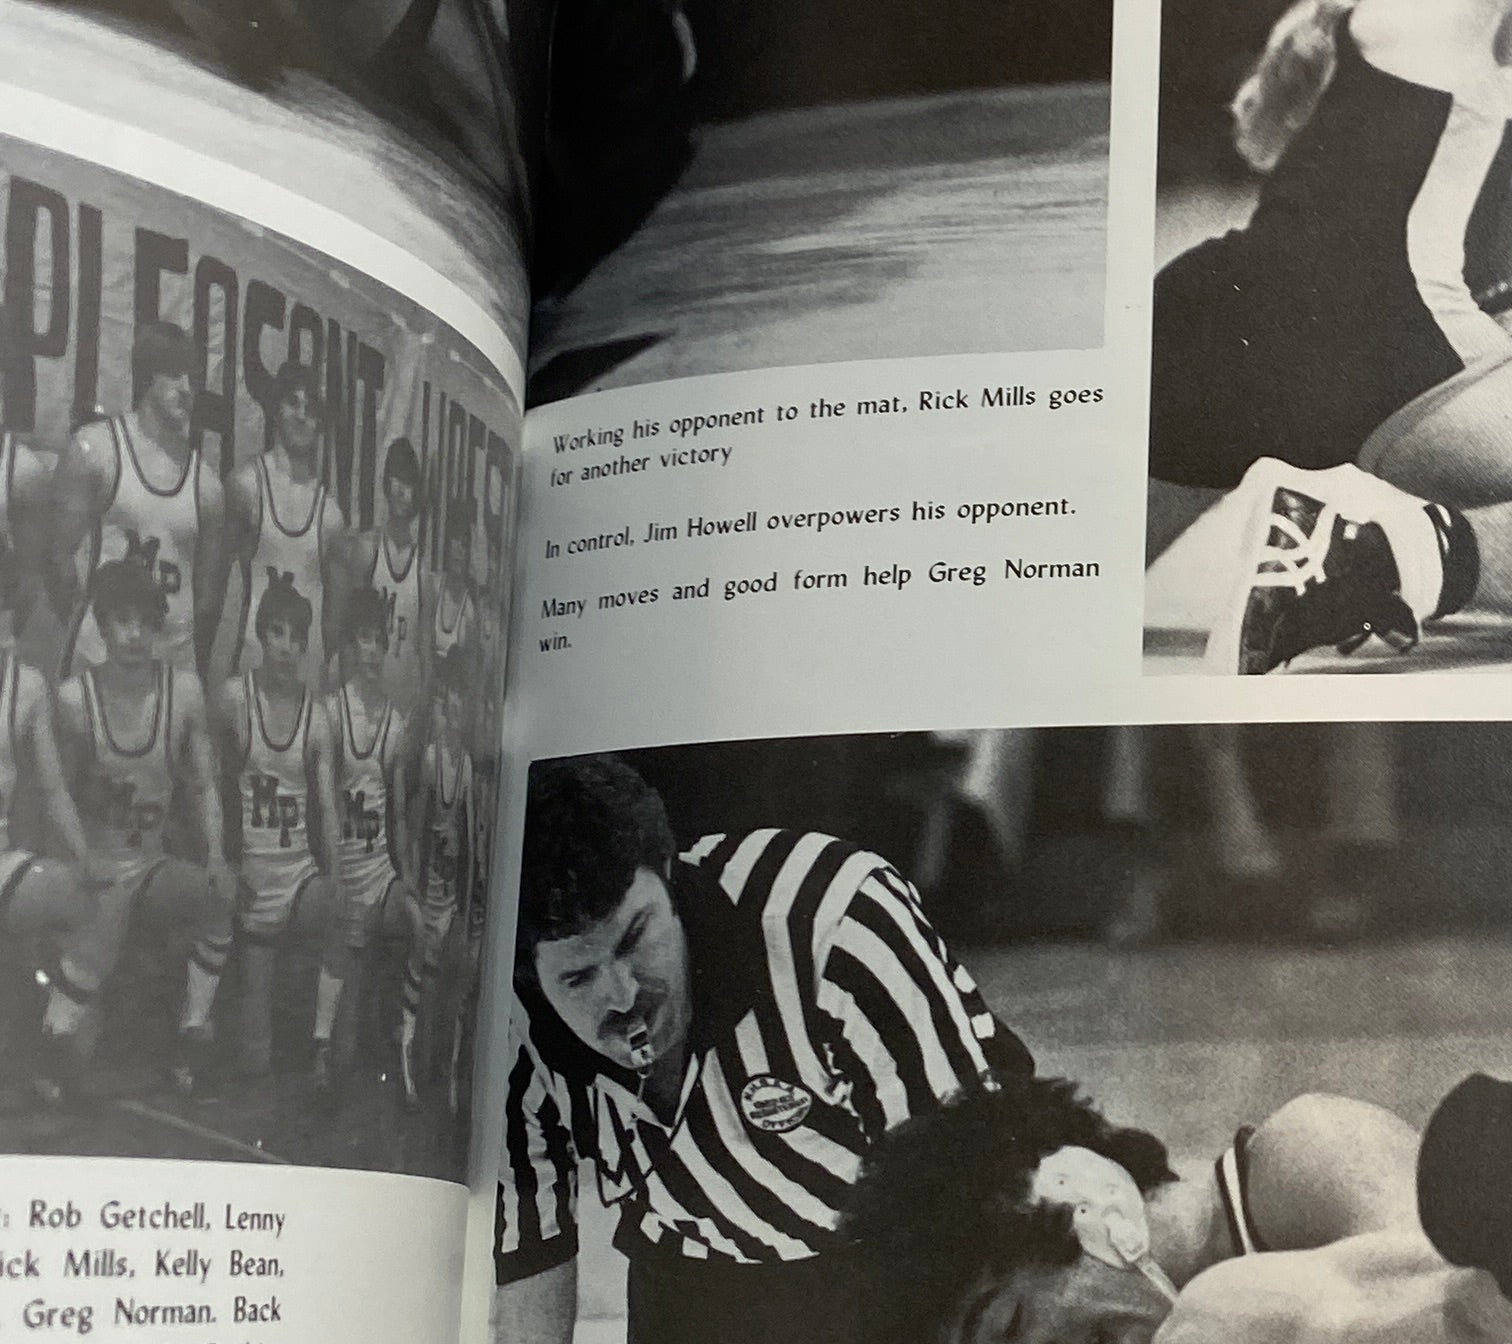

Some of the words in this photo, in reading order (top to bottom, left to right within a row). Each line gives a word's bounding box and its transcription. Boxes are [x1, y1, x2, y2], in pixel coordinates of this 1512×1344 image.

[553, 428, 624, 457] Working
[632, 419, 660, 439] his
[669, 408, 765, 438] opponent
[775, 402, 798, 422] to
[810, 398, 846, 418] the
[857, 397, 907, 415] mat,
[920, 389, 968, 411] Rick
[981, 386, 1036, 407] Mills
[1049, 387, 1104, 409] goes
[550, 466, 574, 488] for
[581, 455, 651, 480] another
[660, 444, 733, 468] victory
[545, 540, 560, 559] In
[567, 526, 634, 554] control,
[643, 523, 677, 543] Jim
[687, 511, 757, 537] Howell
[767, 508, 900, 532] overpowers
[912, 501, 945, 520] his
[957, 499, 1075, 524] opponent.
[540, 597, 587, 620] Many
[598, 587, 659, 610] moves
[672, 577, 709, 600] and
[724, 572, 777, 600] good
[794, 570, 847, 589] form
[864, 564, 911, 590] help
[929, 562, 986, 586] Greg
[1005, 559, 1099, 579] Norman
[538, 632, 572, 654] win.
[29, 1199, 82, 1230] Rob
[100, 1200, 211, 1231] Getchell,
[225, 1203, 285, 1238] Lenny
[64, 1248, 135, 1279] Mills,
[155, 1249, 211, 1284] Kelly
[229, 1249, 284, 1278] Bean,
[23, 1298, 94, 1335] Greg
[114, 1297, 216, 1325] Norman.
[233, 1296, 281, 1323] Back
